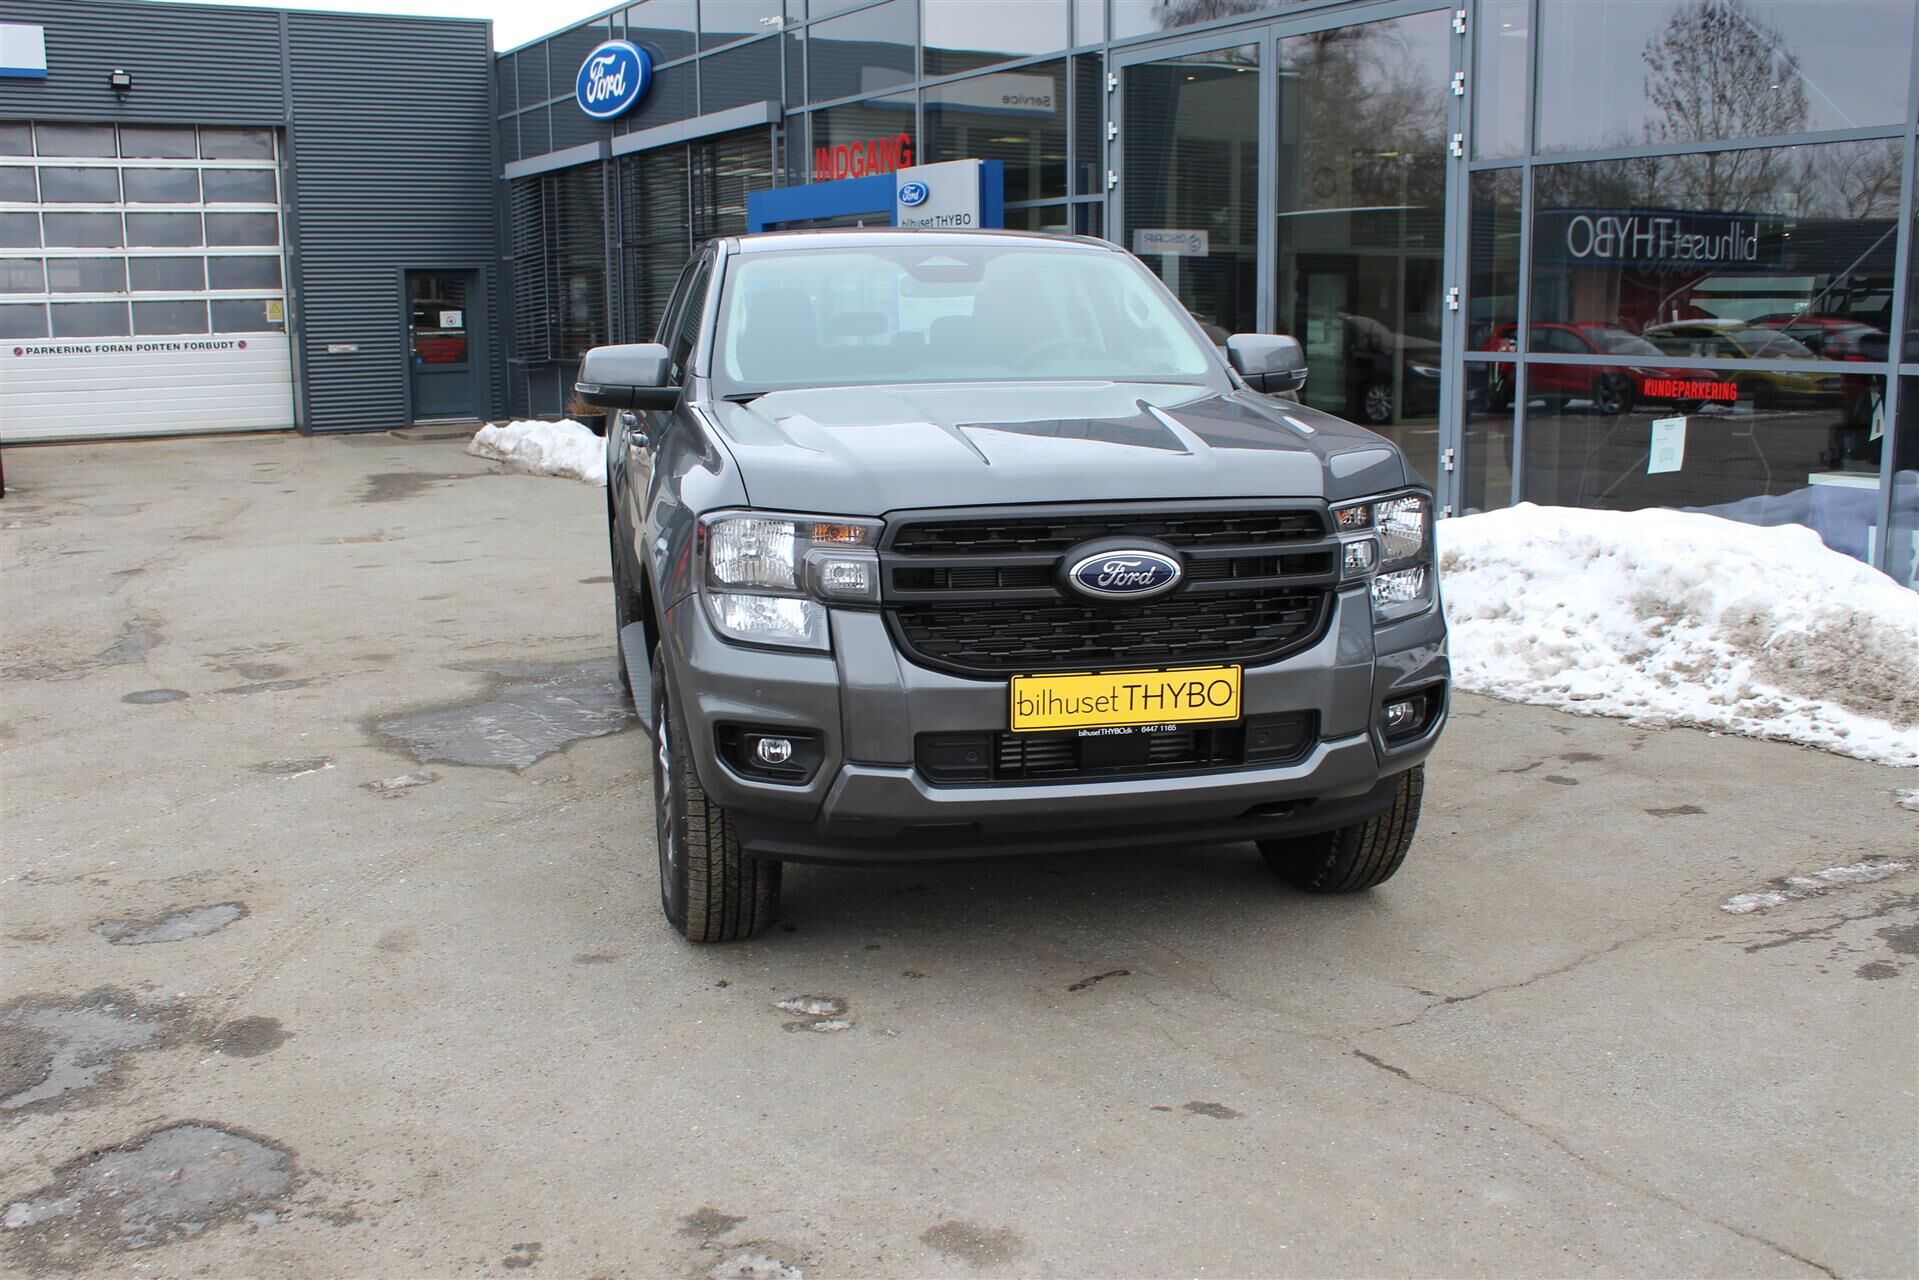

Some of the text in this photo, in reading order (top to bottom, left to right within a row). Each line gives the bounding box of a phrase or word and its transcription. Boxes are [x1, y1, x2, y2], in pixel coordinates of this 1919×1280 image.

[587, 54, 626, 104] Ford
[815, 132, 912, 183] INDGANG
[902, 186, 920, 201] Ford
[935, 213, 971, 227] THYBO
[26, 341, 235, 355] PARKERING FORAN PORTEN FORBUDT
[1644, 378, 1737, 400] KUNDEPARKERING
[1098, 560, 1156, 587] Ford
[1160, 724, 1177, 732] 1165
